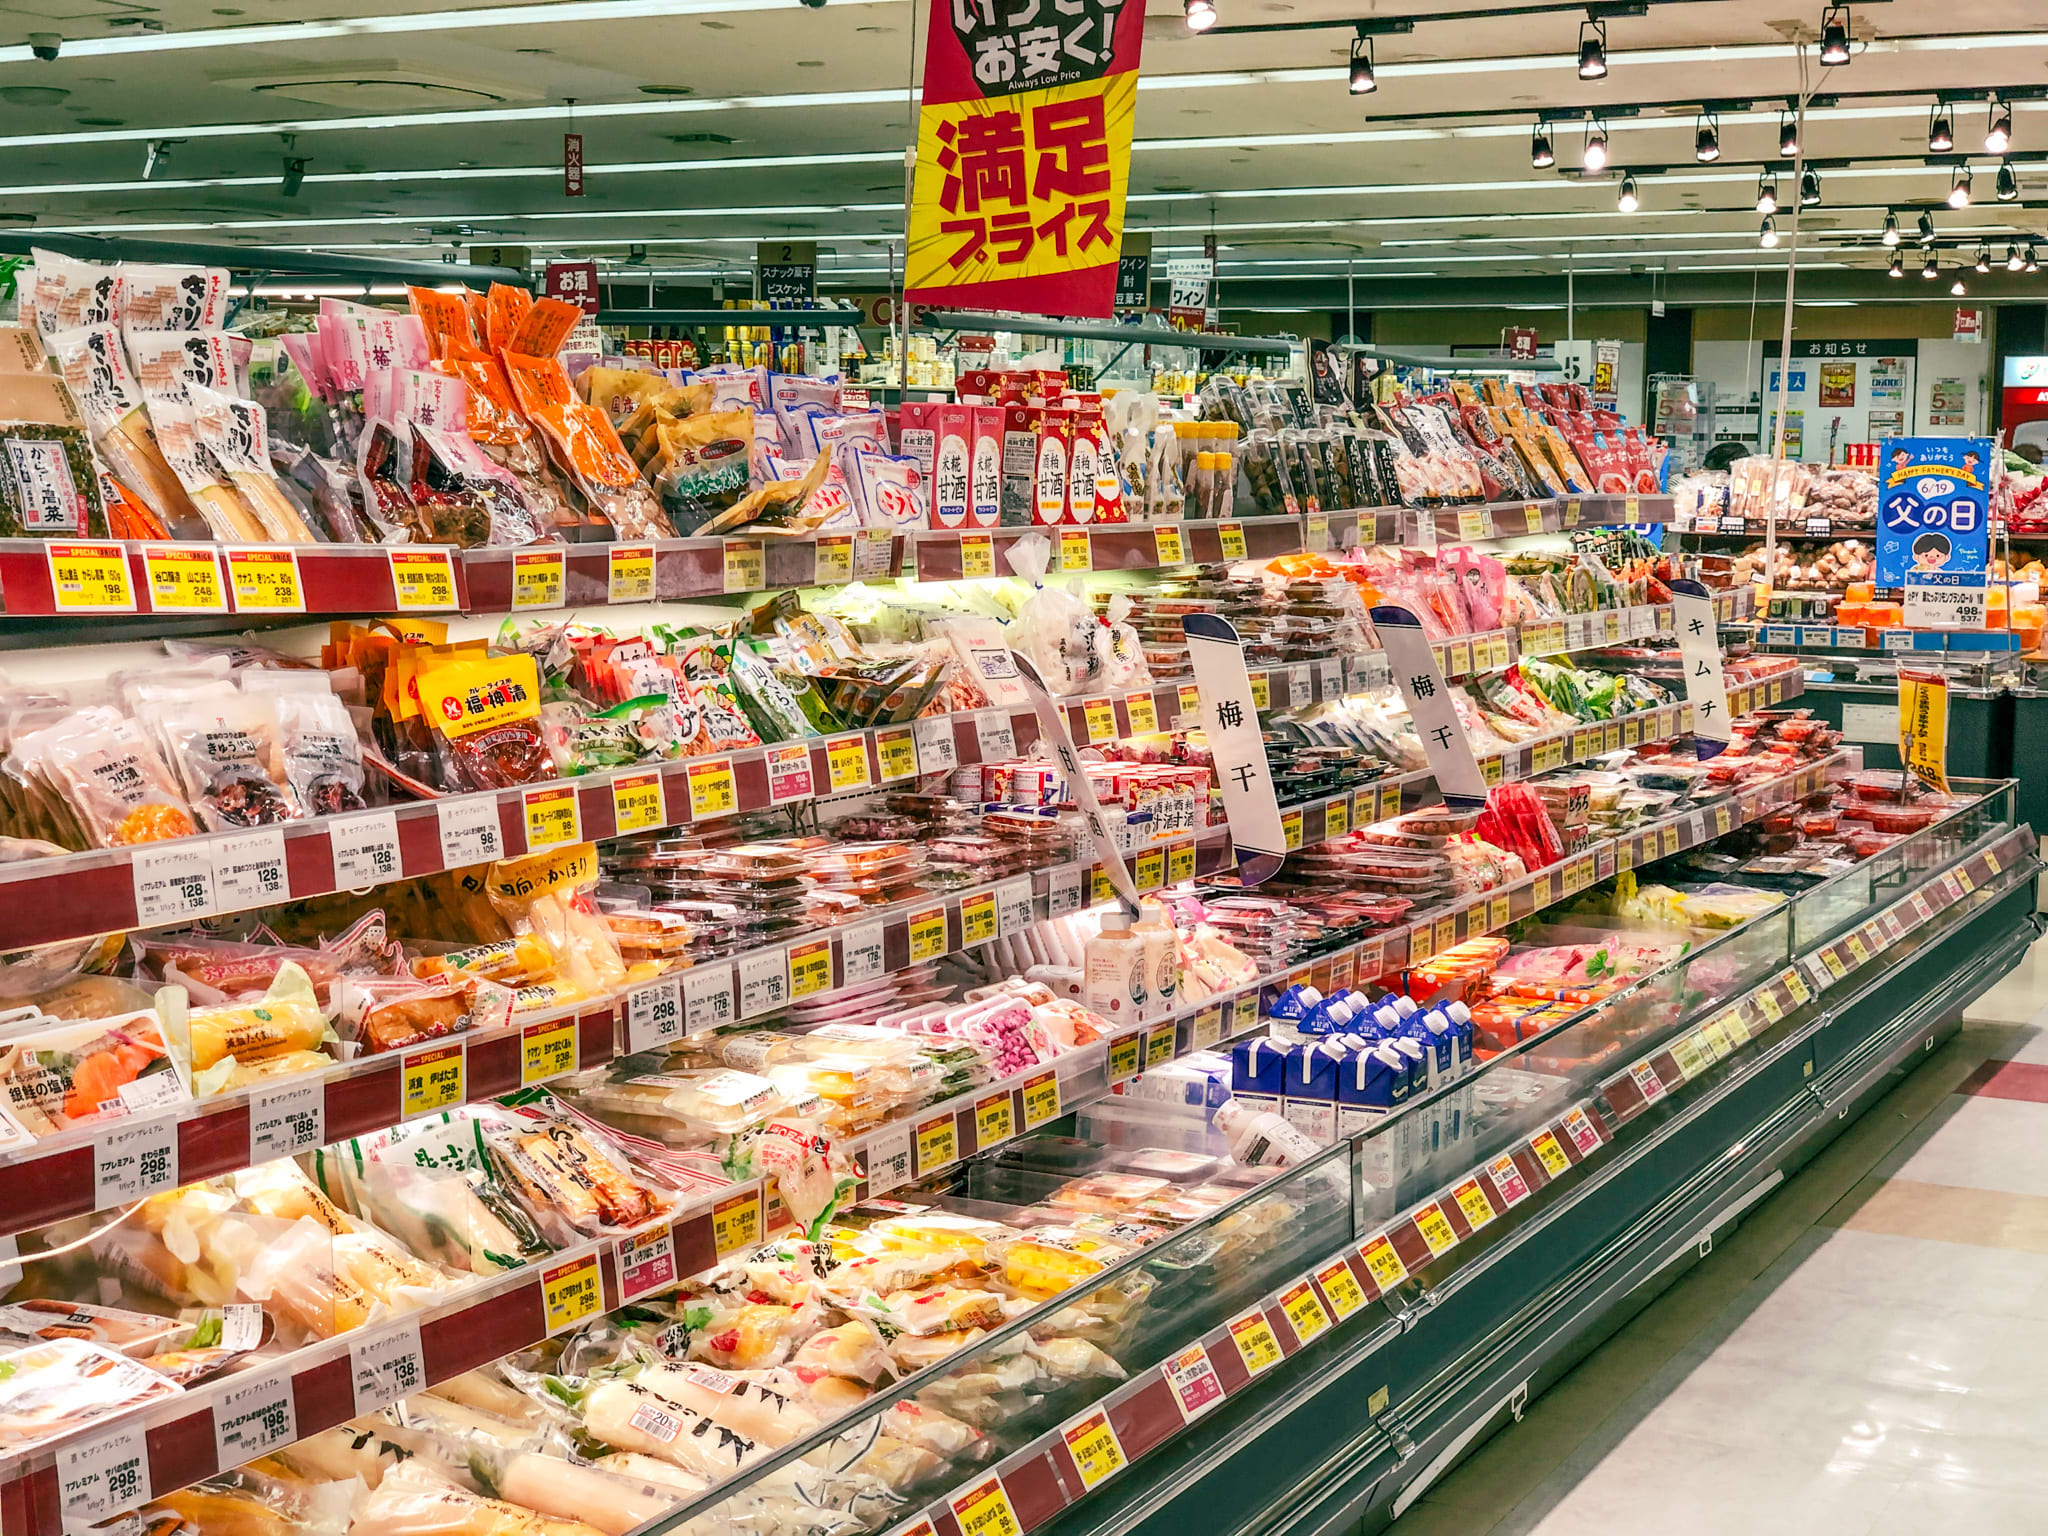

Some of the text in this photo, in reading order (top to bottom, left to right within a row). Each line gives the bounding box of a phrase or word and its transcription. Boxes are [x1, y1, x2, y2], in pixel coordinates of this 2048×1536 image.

[1008, 70, 1081, 91] Always Low Price
[568, 138, 580, 180] 消火器
[936, 95, 1111, 214] 満足
[940, 200, 1114, 270] プライス
[782, 246, 792, 262] 2
[1120, 258, 1146, 271] ワイン
[763, 266, 812, 278] スナック菓子
[559, 269, 588, 292] お酒
[768, 284, 806, 294] ビスケット
[1115, 293, 1144, 305] 豆菓子
[1173, 289, 1205, 306] ワイン
[1809, 344, 1868, 355] お知らせ
[372, 345, 391, 370] 梅
[1564, 357, 1580, 380] 5
[420, 403, 436, 426] 梅
[942, 455, 962, 473] 米糀
[1920, 454, 1954, 462] ありがとう
[1898, 466, 1920, 479] HAPPY
[1956, 469, 1971, 481] DAY
[938, 475, 966, 502] 甘酒
[974, 475, 998, 502] 甘酒
[1039, 472, 1064, 497] 甘酒
[1071, 473, 1095, 498] 甘酒
[1921, 482, 1948, 494] 6/19
[1887, 496, 1976, 531] 父の日
[71, 548, 119, 558] SPECIAL PRICE
[165, 550, 211, 561] SPECIAL PRICE
[247, 553, 272, 562] SPECIAL
[407, 554, 429, 562] SPECIAL
[1932, 576, 1960, 585] 父の日
[104, 585, 121, 594] 198
[194, 587, 212, 595] 248
[275, 587, 292, 596] 238
[432, 586, 446, 595] 298
[1956, 607, 1978, 615] 498
[1687, 618, 1718, 720] キムチ
[465, 684, 527, 715] 福神漬
[1410, 675, 1454, 750] 梅干
[999, 735, 1010, 744] 158
[939, 744, 950, 754] 158
[1216, 701, 1257, 793] 梅干
[699, 764, 718, 774] SPECIAL
[626, 776, 644, 786] SPECIAL
[539, 790, 558, 801] SPECIAL
[721, 792, 730, 801] 98
[645, 807, 657, 816] 278
[562, 821, 572, 830] 98
[480, 833, 493, 845] 98
[483, 846, 494, 854] 105
[155, 853, 199, 865] セブンプレミアム
[372, 850, 391, 865] 128
[258, 868, 278, 883] 128
[379, 864, 392, 874] 138
[181, 883, 203, 898] 128
[265, 881, 279, 892] 138
[189, 898, 204, 908] 138
[867, 952, 879, 963] 178
[768, 982, 781, 995] 178
[653, 1000, 675, 1021] 298
[714, 999, 727, 1011] 178
[538, 1023, 559, 1034] SPECIAL
[661, 1019, 676, 1034] 321
[421, 1051, 444, 1063] SPECIAL
[555, 1052, 569, 1063] 238
[9, 1075, 77, 1104] 銀鮭の塩焼
[440, 1083, 456, 1095] 298
[271, 1089, 312, 1103] セブンプレミアム
[117, 1126, 164, 1142] セブンプレミアム
[297, 1133, 313, 1145] 203
[100, 1157, 135, 1172] 7プレミアム
[893, 1159, 905, 1172] 188
[150, 1172, 166, 1184] 321
[558, 1263, 579, 1278] SPECIAL
[580, 1292, 595, 1305] 298
[370, 1331, 410, 1353] セブンプレミアム
[394, 1362, 415, 1382] 138
[401, 1376, 415, 1388] 149
[235, 1378, 279, 1401] セブンプレミアム
[271, 1424, 286, 1439] 213
[81, 1435, 131, 1458] セブンプレミアム
[65, 1474, 100, 1492] 7プレミアム
[120, 1484, 137, 1500] 321
[966, 1489, 985, 1506] SPECIAL
[999, 1516, 1009, 1529] 98
